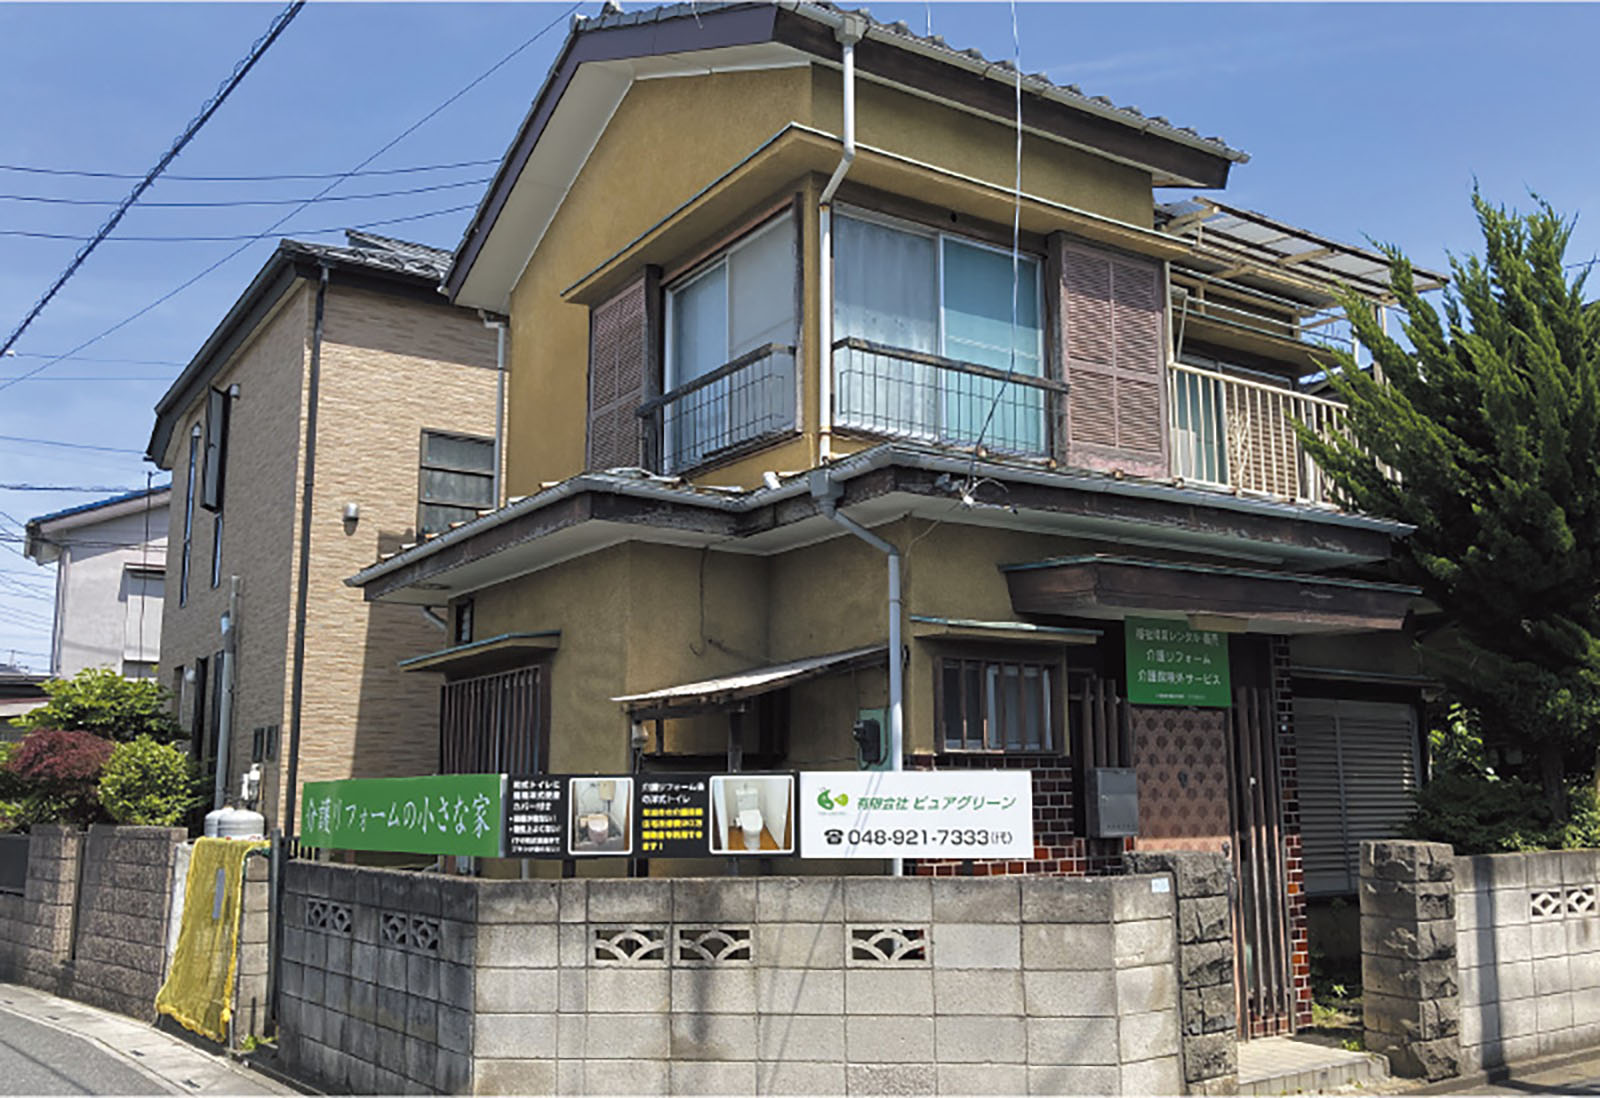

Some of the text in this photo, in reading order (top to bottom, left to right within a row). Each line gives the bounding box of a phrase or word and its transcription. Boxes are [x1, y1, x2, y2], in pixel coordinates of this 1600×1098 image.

[1146, 649, 1212, 665] 介護リフォーム
[857, 796, 1016, 811] 有限会社 ピュアグリーン
[305, 792, 491, 839] 介護リフォームの小さな家
